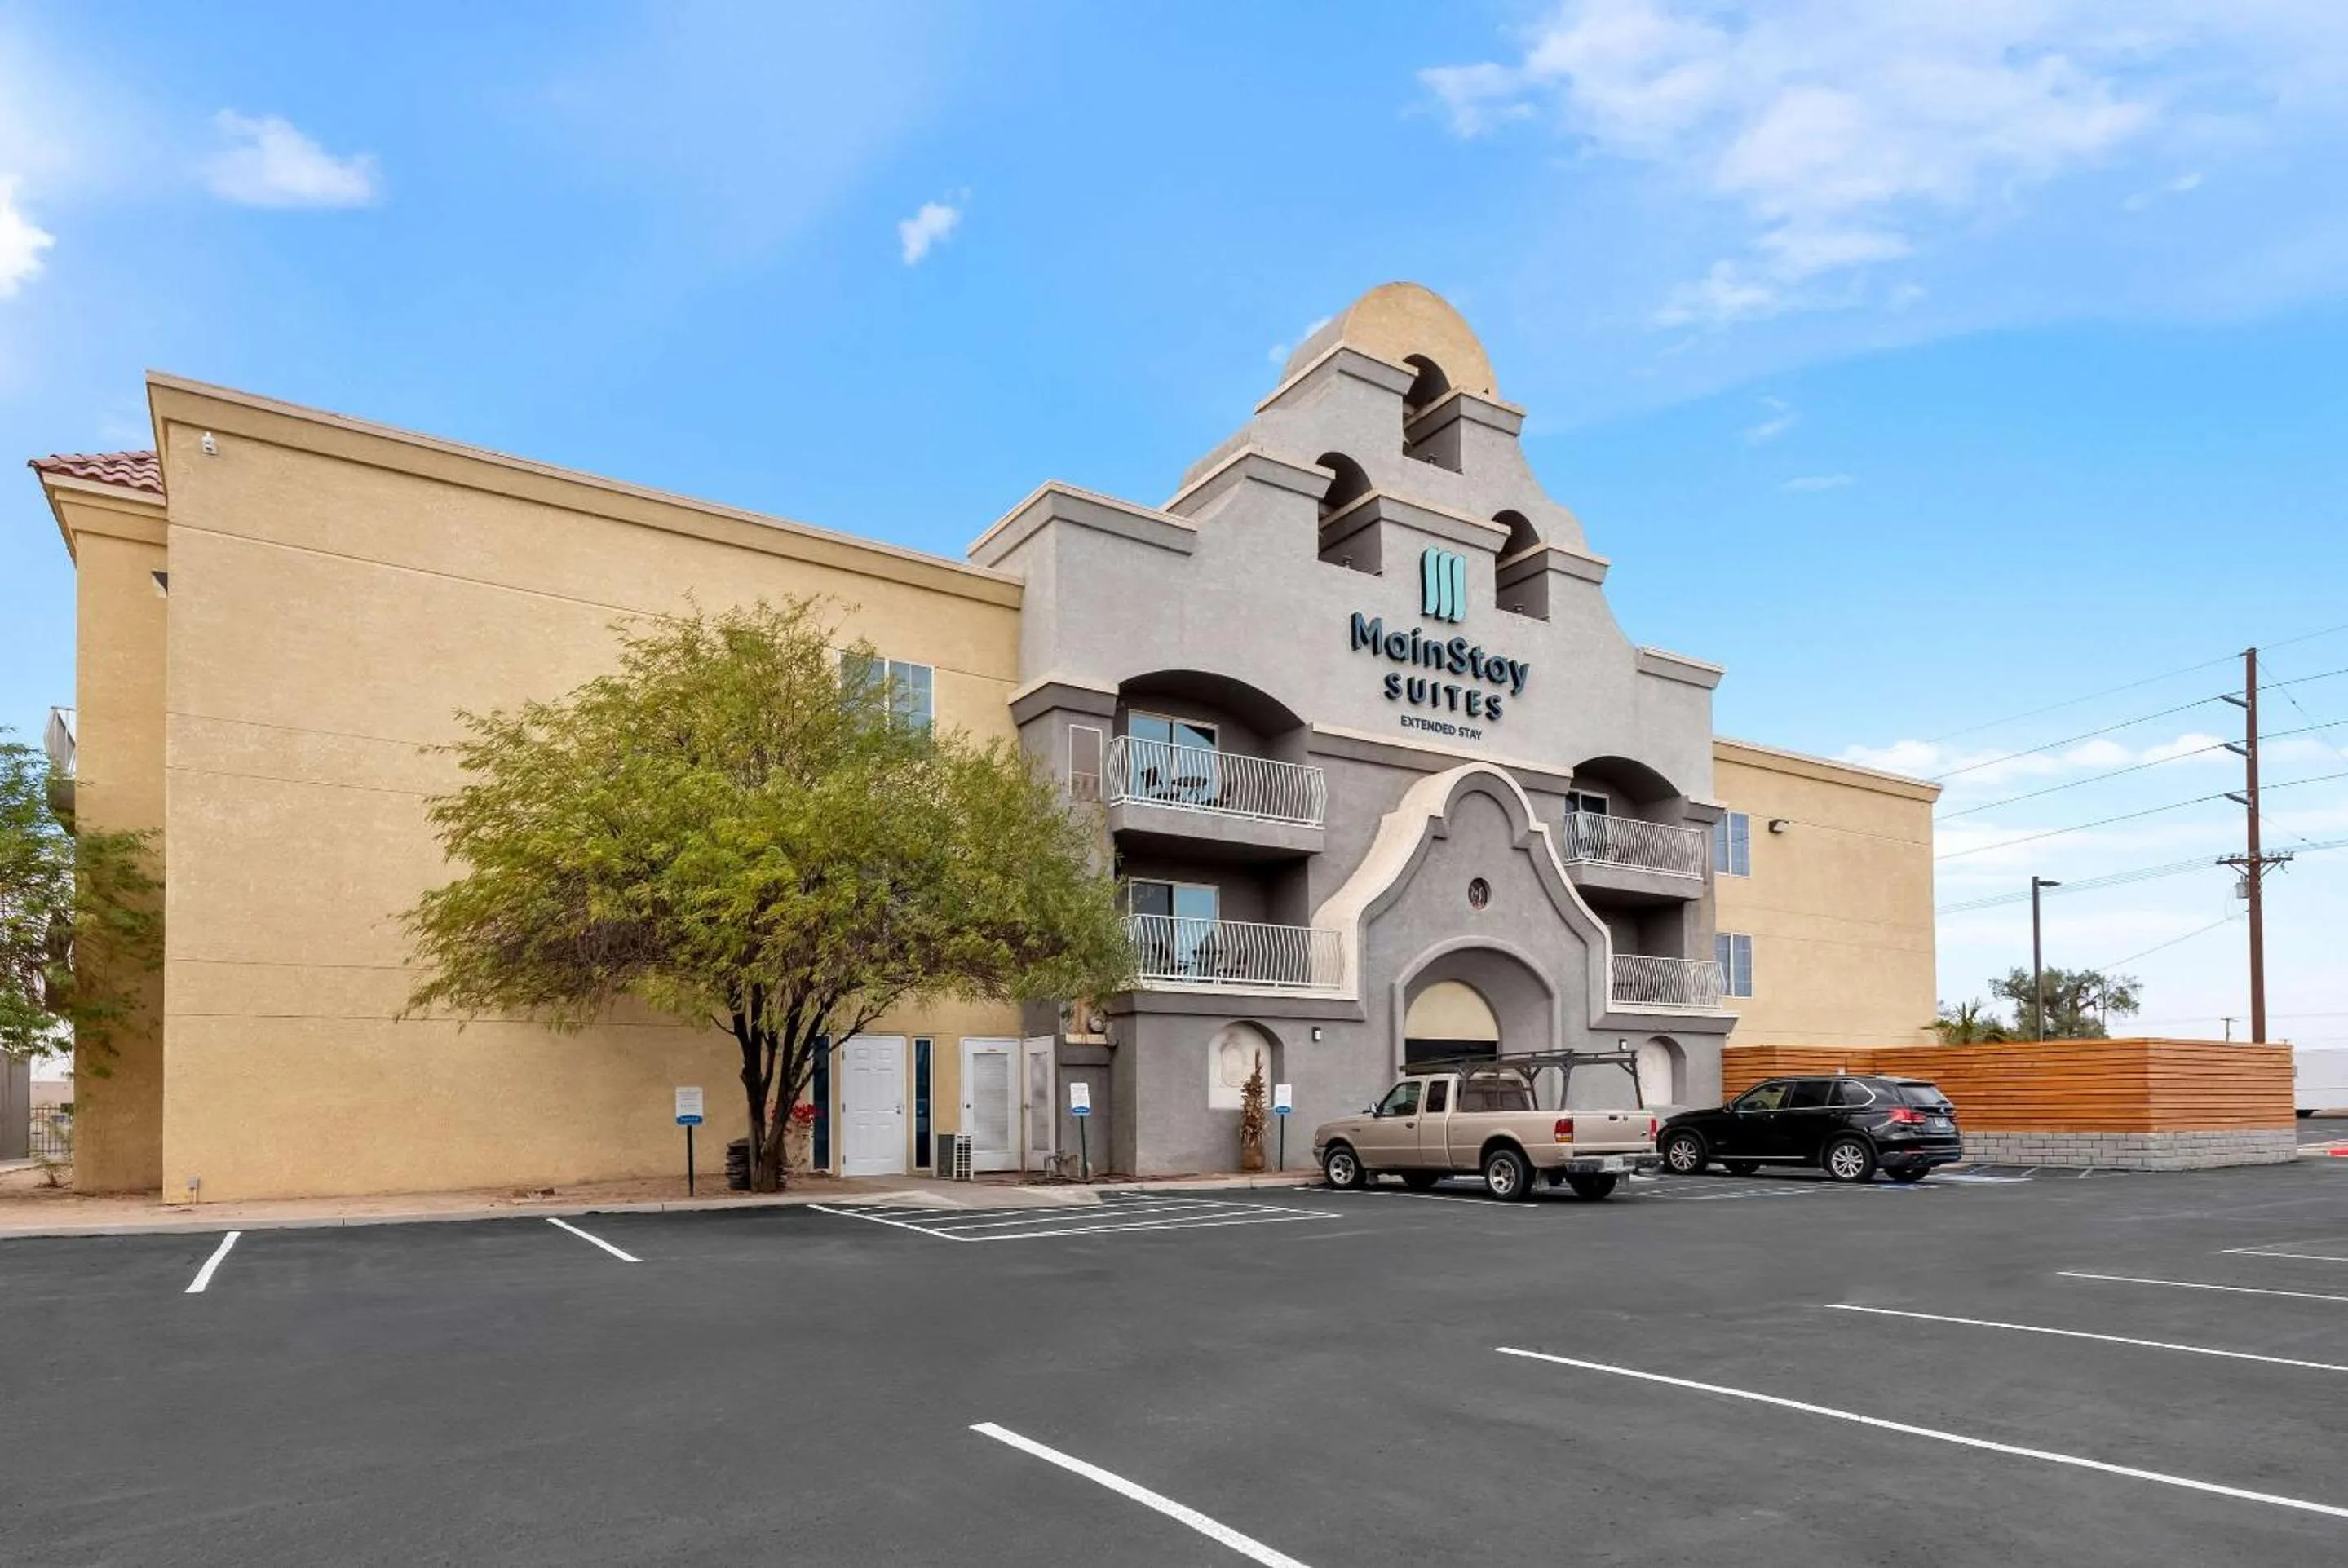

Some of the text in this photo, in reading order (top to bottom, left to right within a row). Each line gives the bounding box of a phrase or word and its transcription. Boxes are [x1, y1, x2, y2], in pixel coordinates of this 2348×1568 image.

[1351, 612, 1530, 696] MainStay
[1384, 672, 1503, 722] SUITES
[1400, 715, 1483, 740] EXTENDED STAY
